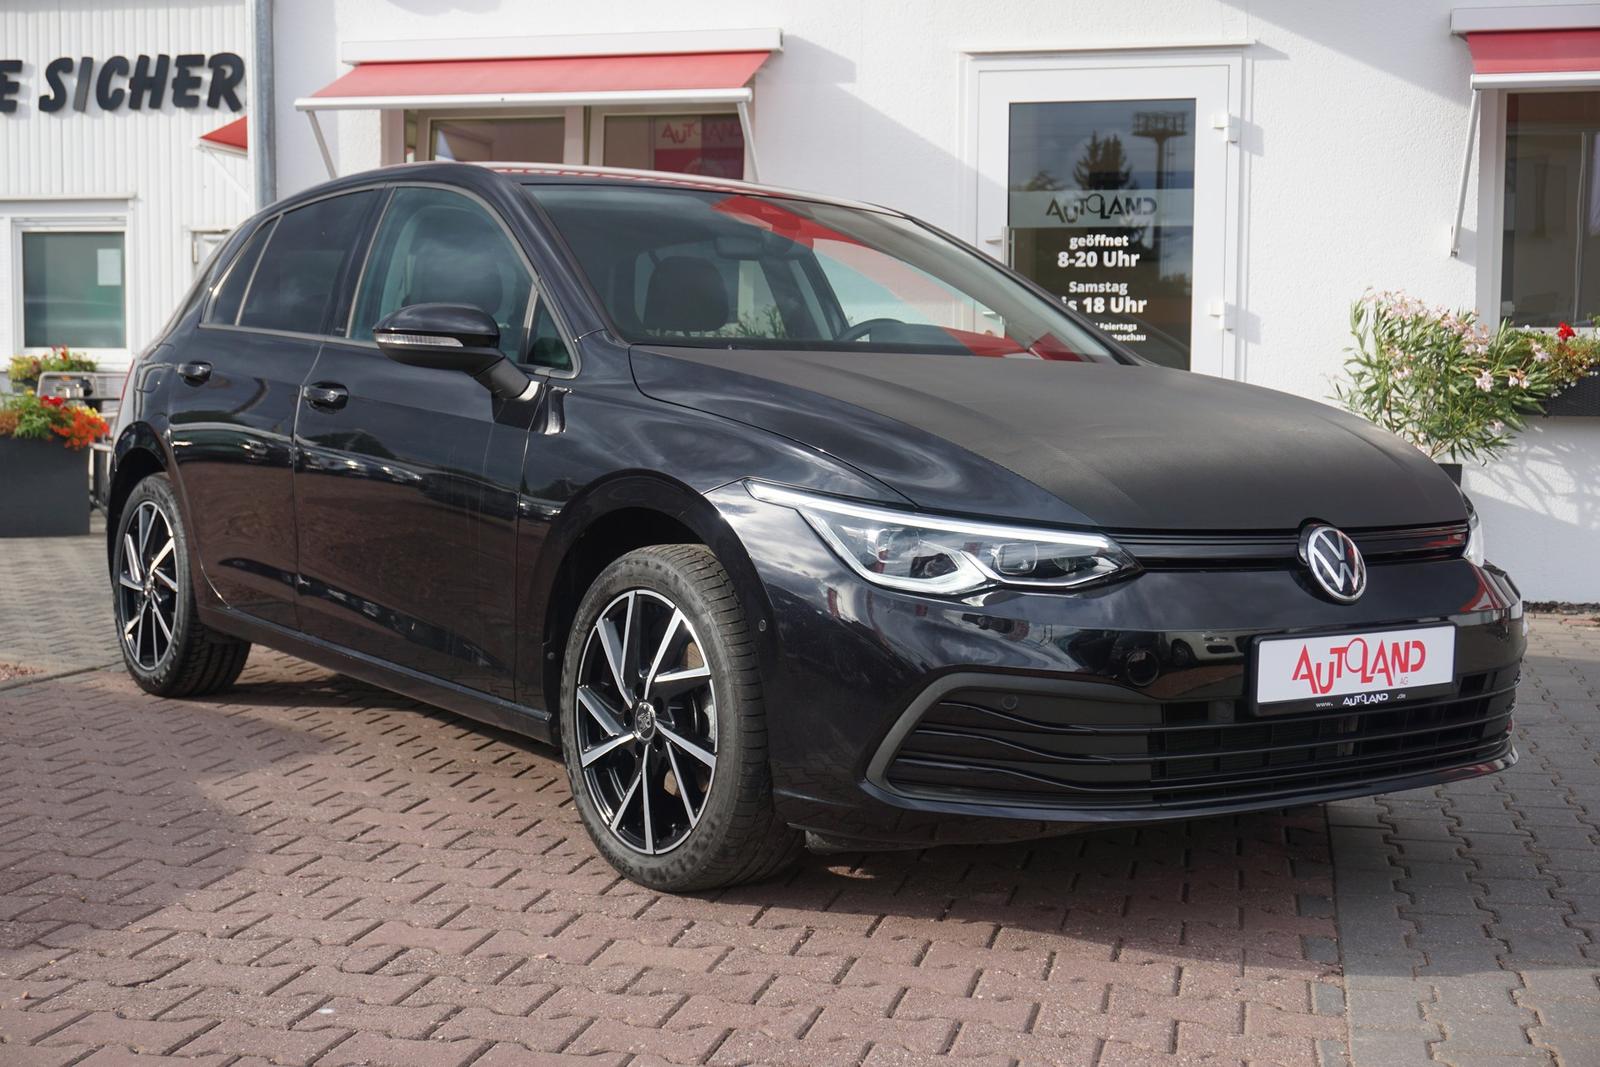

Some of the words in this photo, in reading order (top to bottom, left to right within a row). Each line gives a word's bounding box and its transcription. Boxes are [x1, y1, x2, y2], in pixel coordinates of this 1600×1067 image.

[38, 52, 245, 112] SICHER
[1046, 193, 1157, 224] AUTOLAND
[1069, 234, 1129, 250] geöffnet
[1057, 251, 1098, 267] 8-20
[1103, 250, 1140, 267] Uhr
[1069, 281, 1128, 296] Samstag
[1082, 297, 1105, 313] 18
[1110, 296, 1147, 313] Uhr
[1292, 637, 1426, 694] AUTOLAND
[1343, 693, 1388, 706] AUTOLAND
